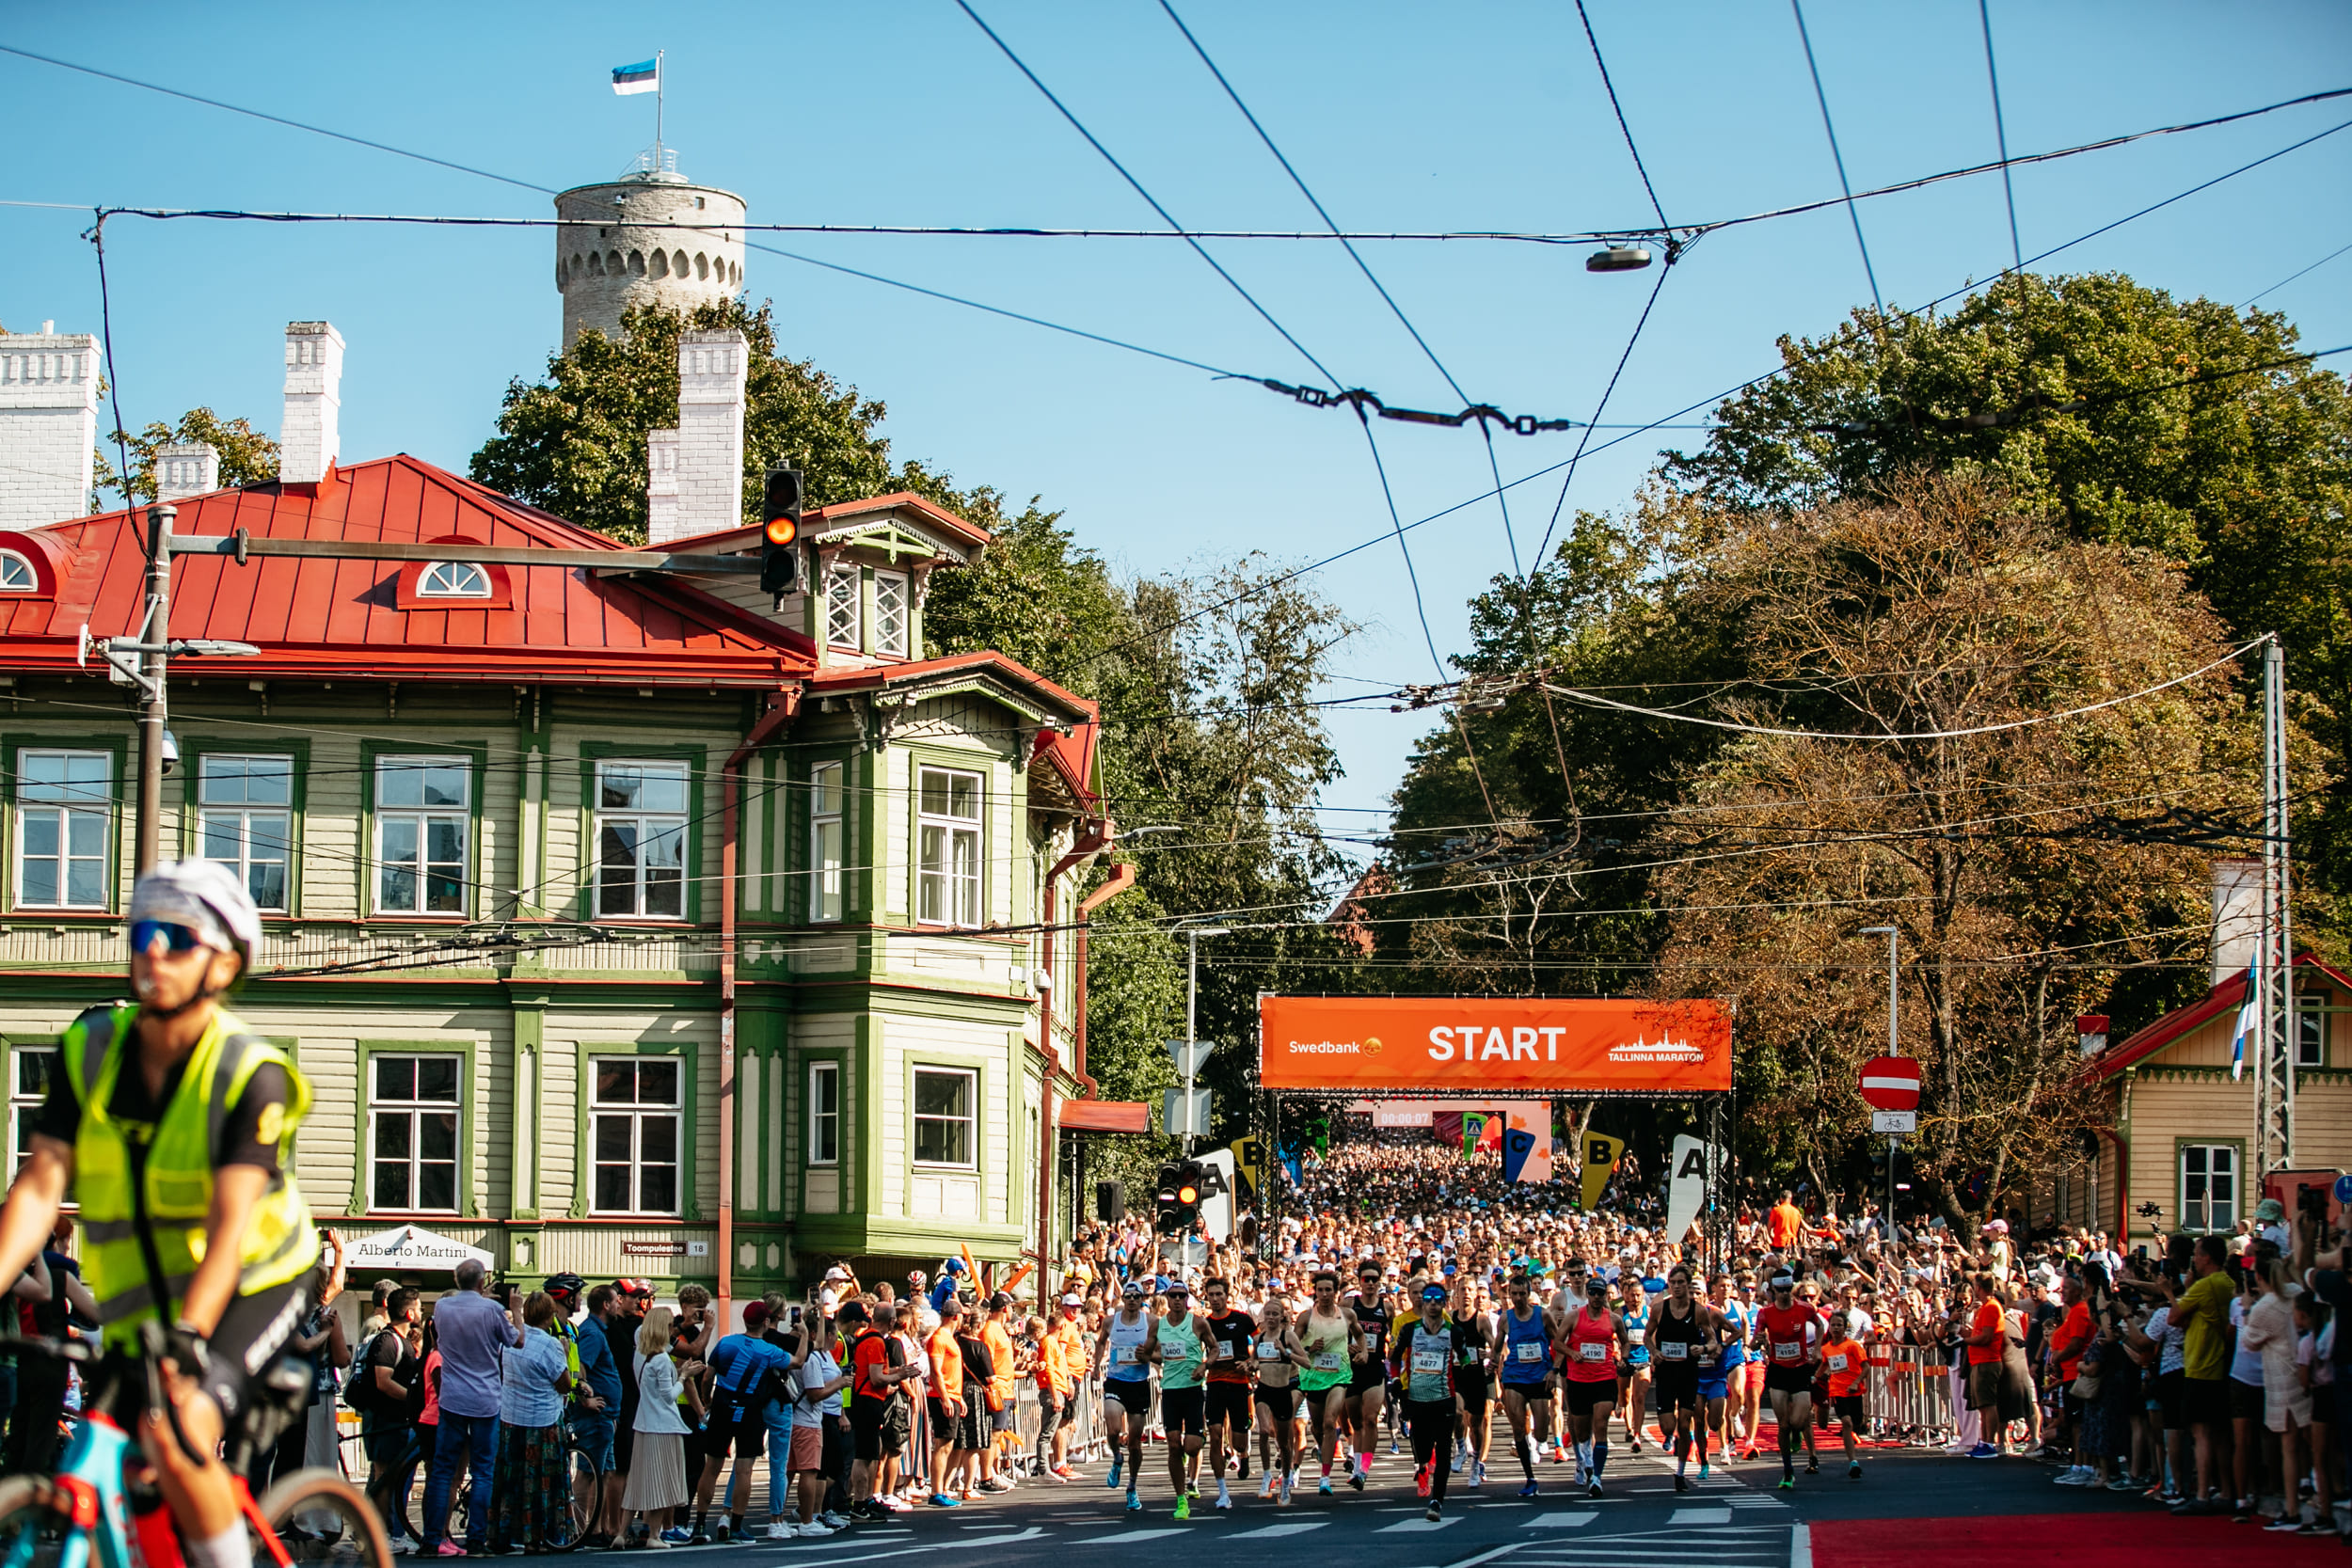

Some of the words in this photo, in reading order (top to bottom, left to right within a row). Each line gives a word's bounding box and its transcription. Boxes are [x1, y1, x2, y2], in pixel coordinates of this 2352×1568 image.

[1289, 1040, 1360, 1053] Swedbank
[1428, 1026, 1566, 1061] START
[1608, 1053, 1654, 1062] TALLINNA
[1656, 1053, 1704, 1062] MARATON
[1381, 1113, 1429, 1124] 00:00:07
[1511, 1134, 1526, 1153] C
[1589, 1140, 1613, 1164] B
[1677, 1148, 1709, 1180] A
[358, 1243, 412, 1257] Alberto
[416, 1245, 467, 1258] Martini
[627, 1243, 683, 1254] Toompuiestee
